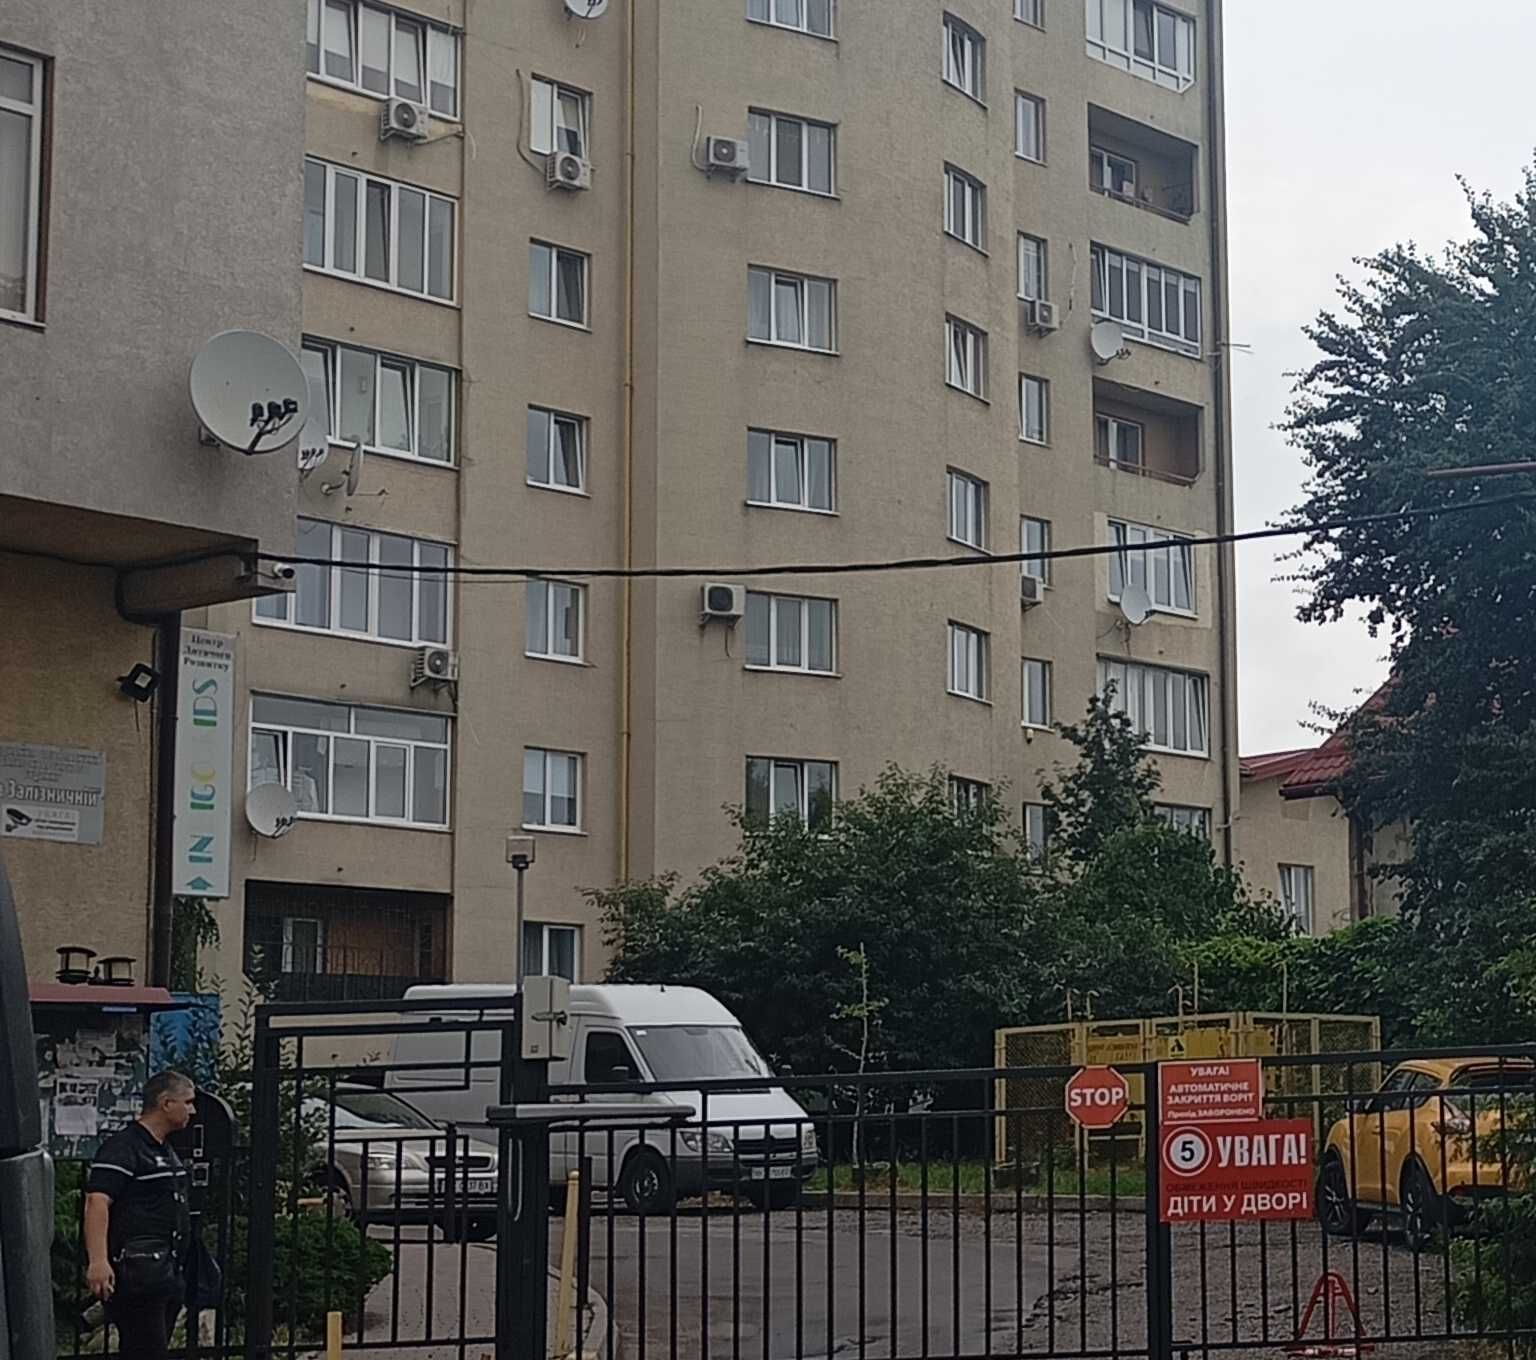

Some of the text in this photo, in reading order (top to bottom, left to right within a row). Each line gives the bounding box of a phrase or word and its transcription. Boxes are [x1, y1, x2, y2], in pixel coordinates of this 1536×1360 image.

[1189, 1065, 1230, 1078] УВАГА!
[1069, 1087, 1125, 1108] STOP
[1169, 1081, 1249, 1094] АВТОМАТИЧНЕ
[1167, 1092, 1256, 1106] ЗАКРИТТЯ ВОРІТ
[1181, 1140, 1195, 1162] 5
[1216, 1132, 1308, 1169] УВАГА!
[1167, 1191, 1308, 1217] ДІТИ У ДВОРІ
